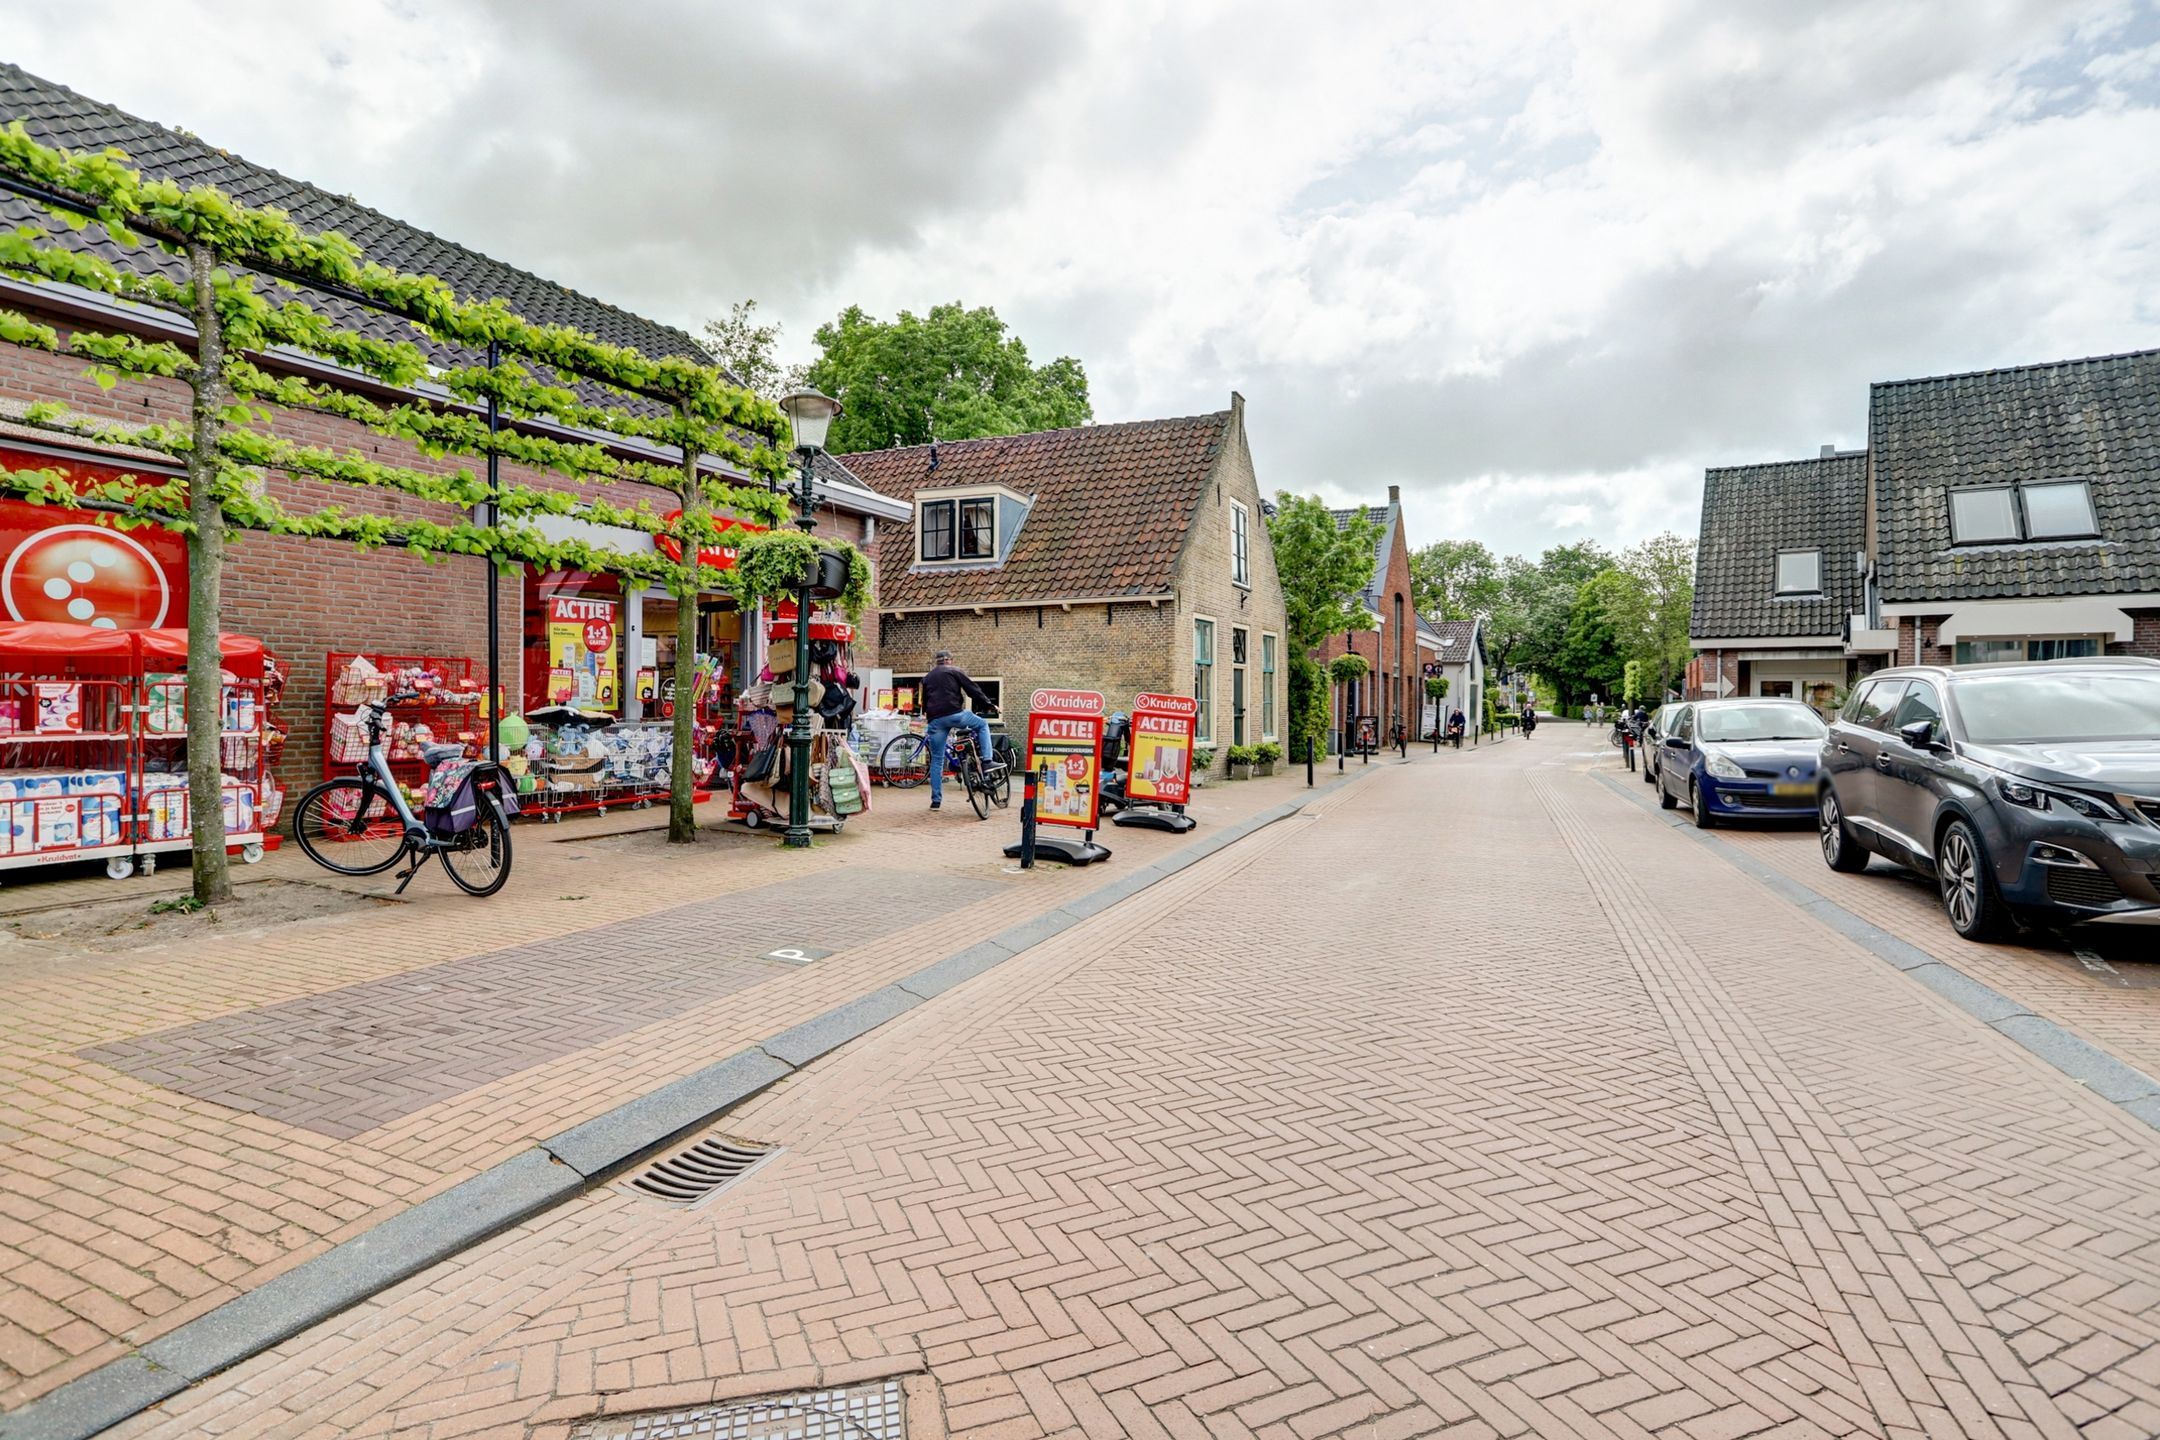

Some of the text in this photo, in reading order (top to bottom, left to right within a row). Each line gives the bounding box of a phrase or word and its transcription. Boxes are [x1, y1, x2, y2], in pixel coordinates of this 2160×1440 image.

[555, 600, 611, 622] ACTIE!
[587, 625, 609, 640] 1+1
[1048, 694, 1098, 710] Kruidvat
[1150, 697, 1192, 711] Kruidvat
[1038, 718, 1094, 739] ACTIE!
[1140, 716, 1188, 734] ACTIE!
[1067, 759, 1085, 771] 1+1
[41, 853, 77, 863] Kruidvat
